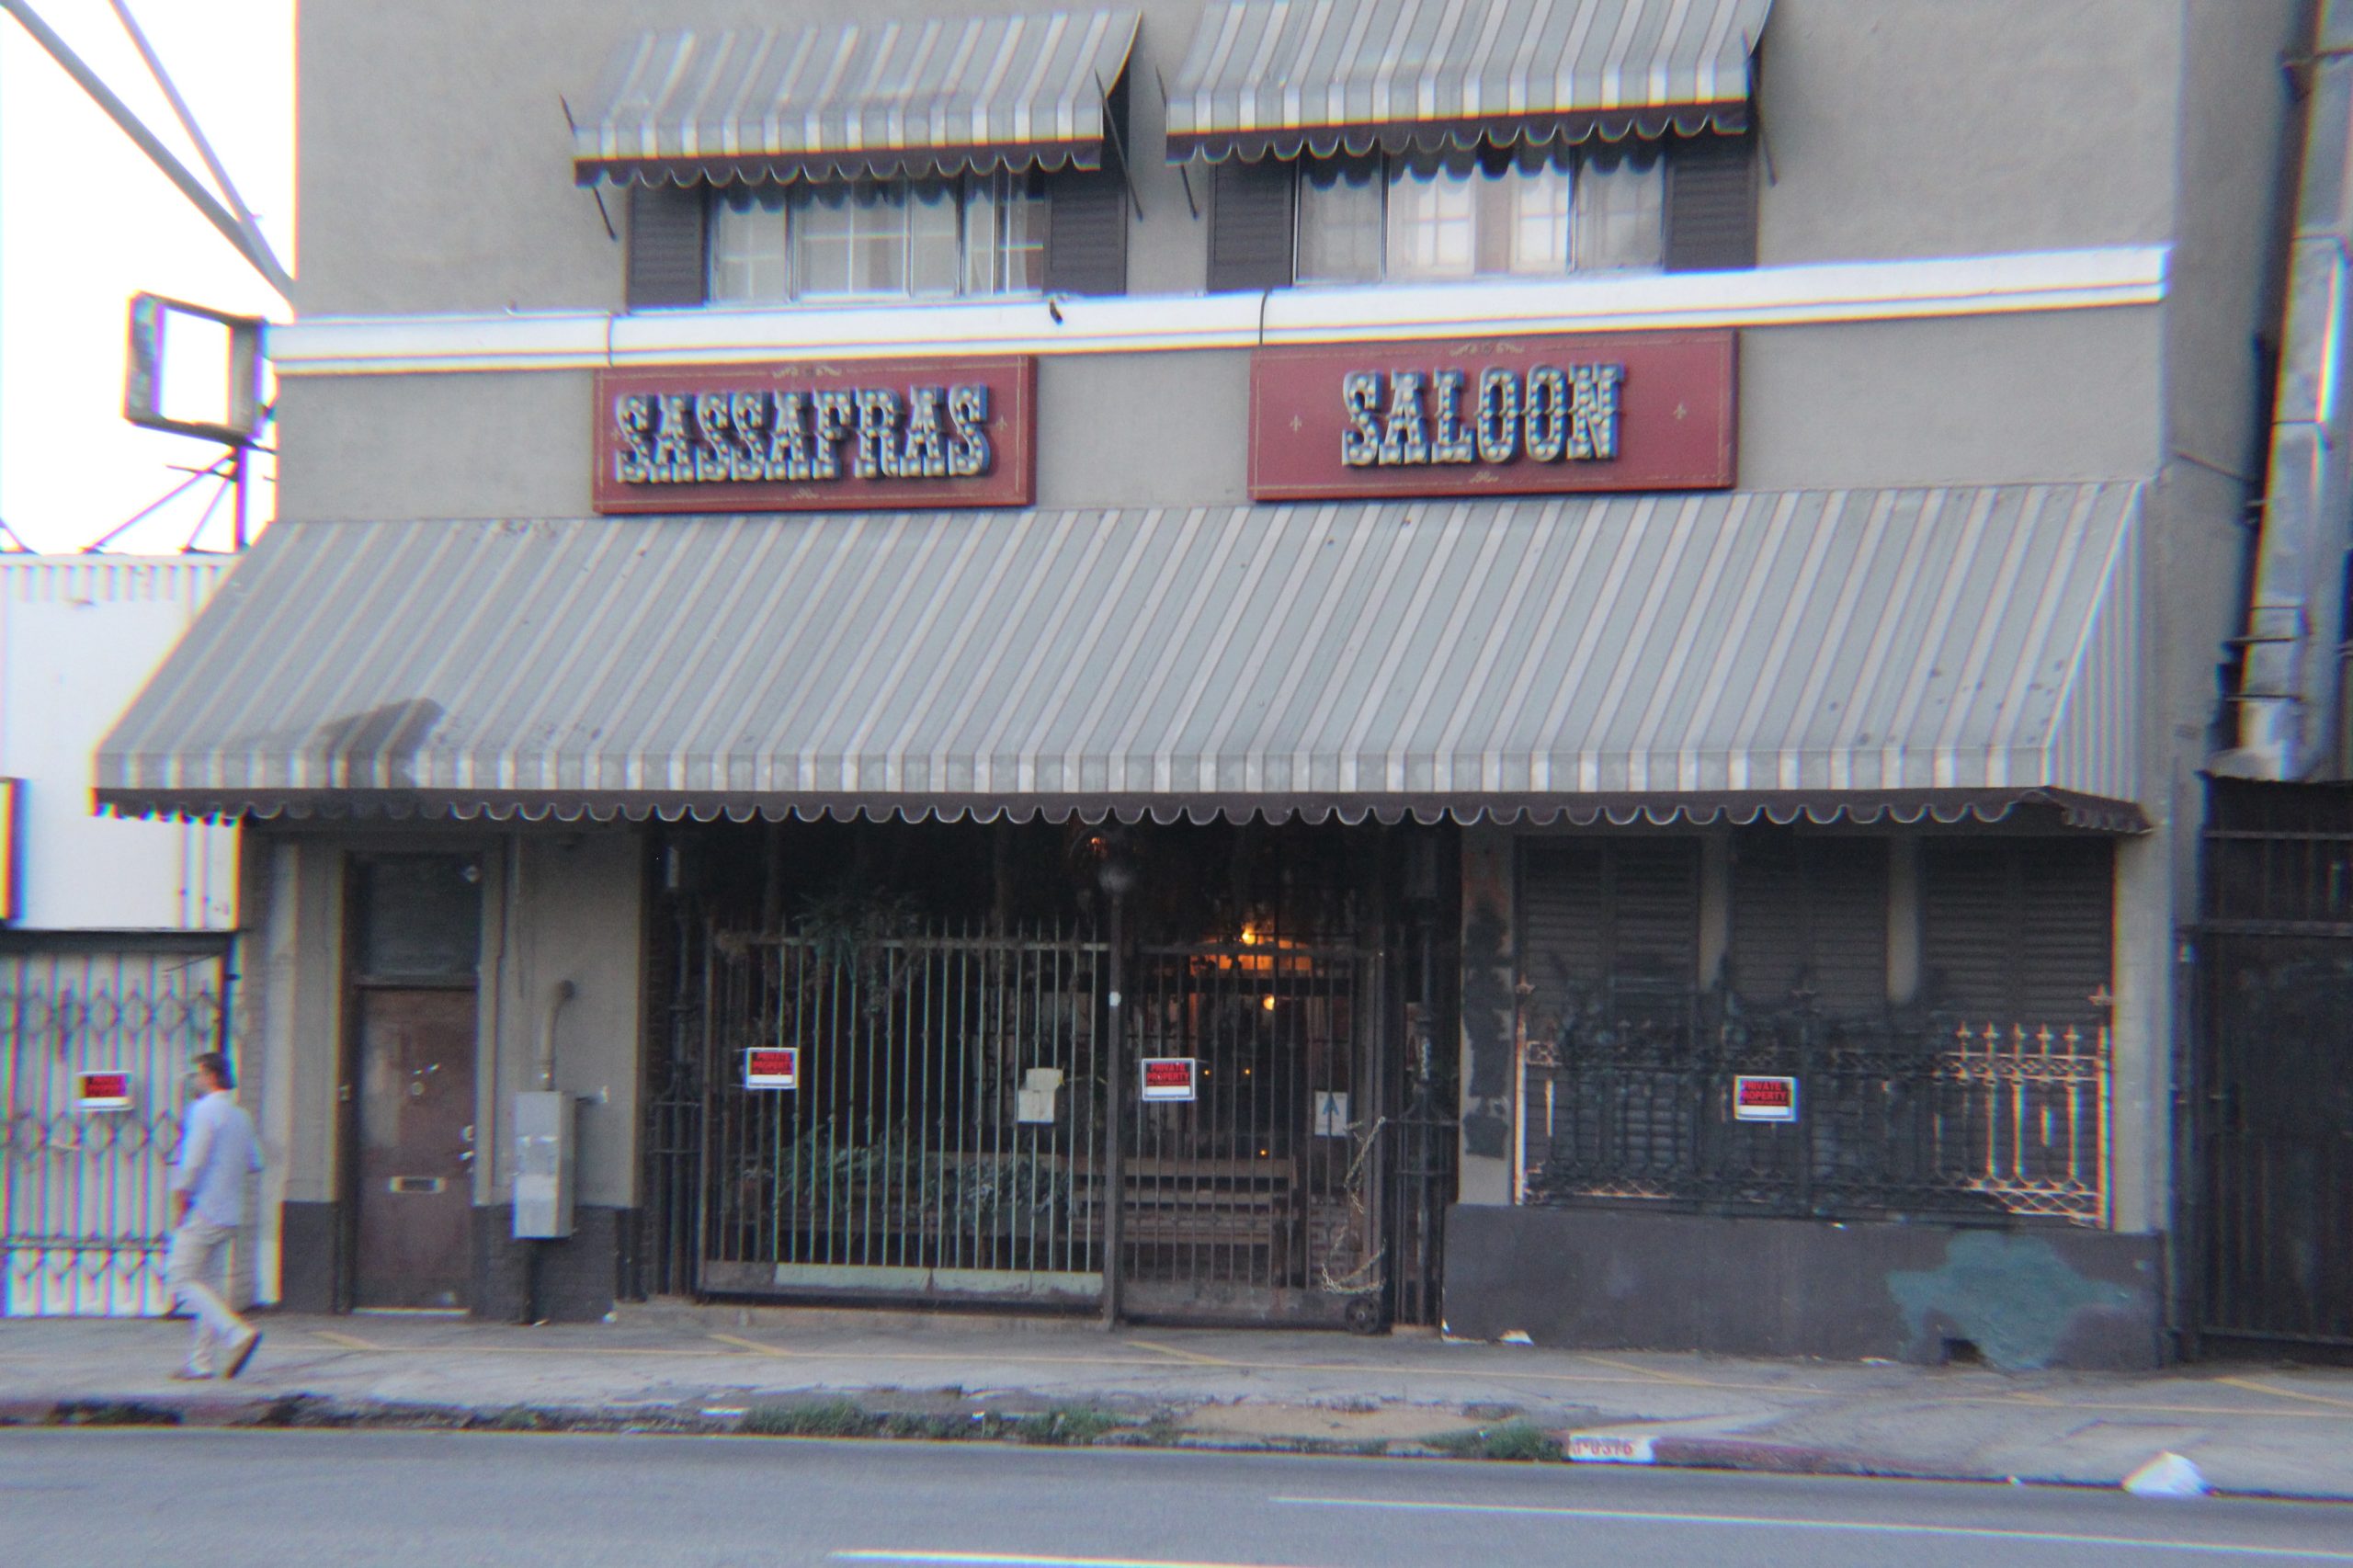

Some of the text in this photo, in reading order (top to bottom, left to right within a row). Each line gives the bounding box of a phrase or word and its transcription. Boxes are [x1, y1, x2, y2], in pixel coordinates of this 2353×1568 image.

[614, 384, 993, 484] SASSAFRAS
[1341, 361, 1625, 467] SALOON
[1739, 1091, 1787, 1101] PROPERTY
[1742, 1080, 1781, 1091] PRIVATE
